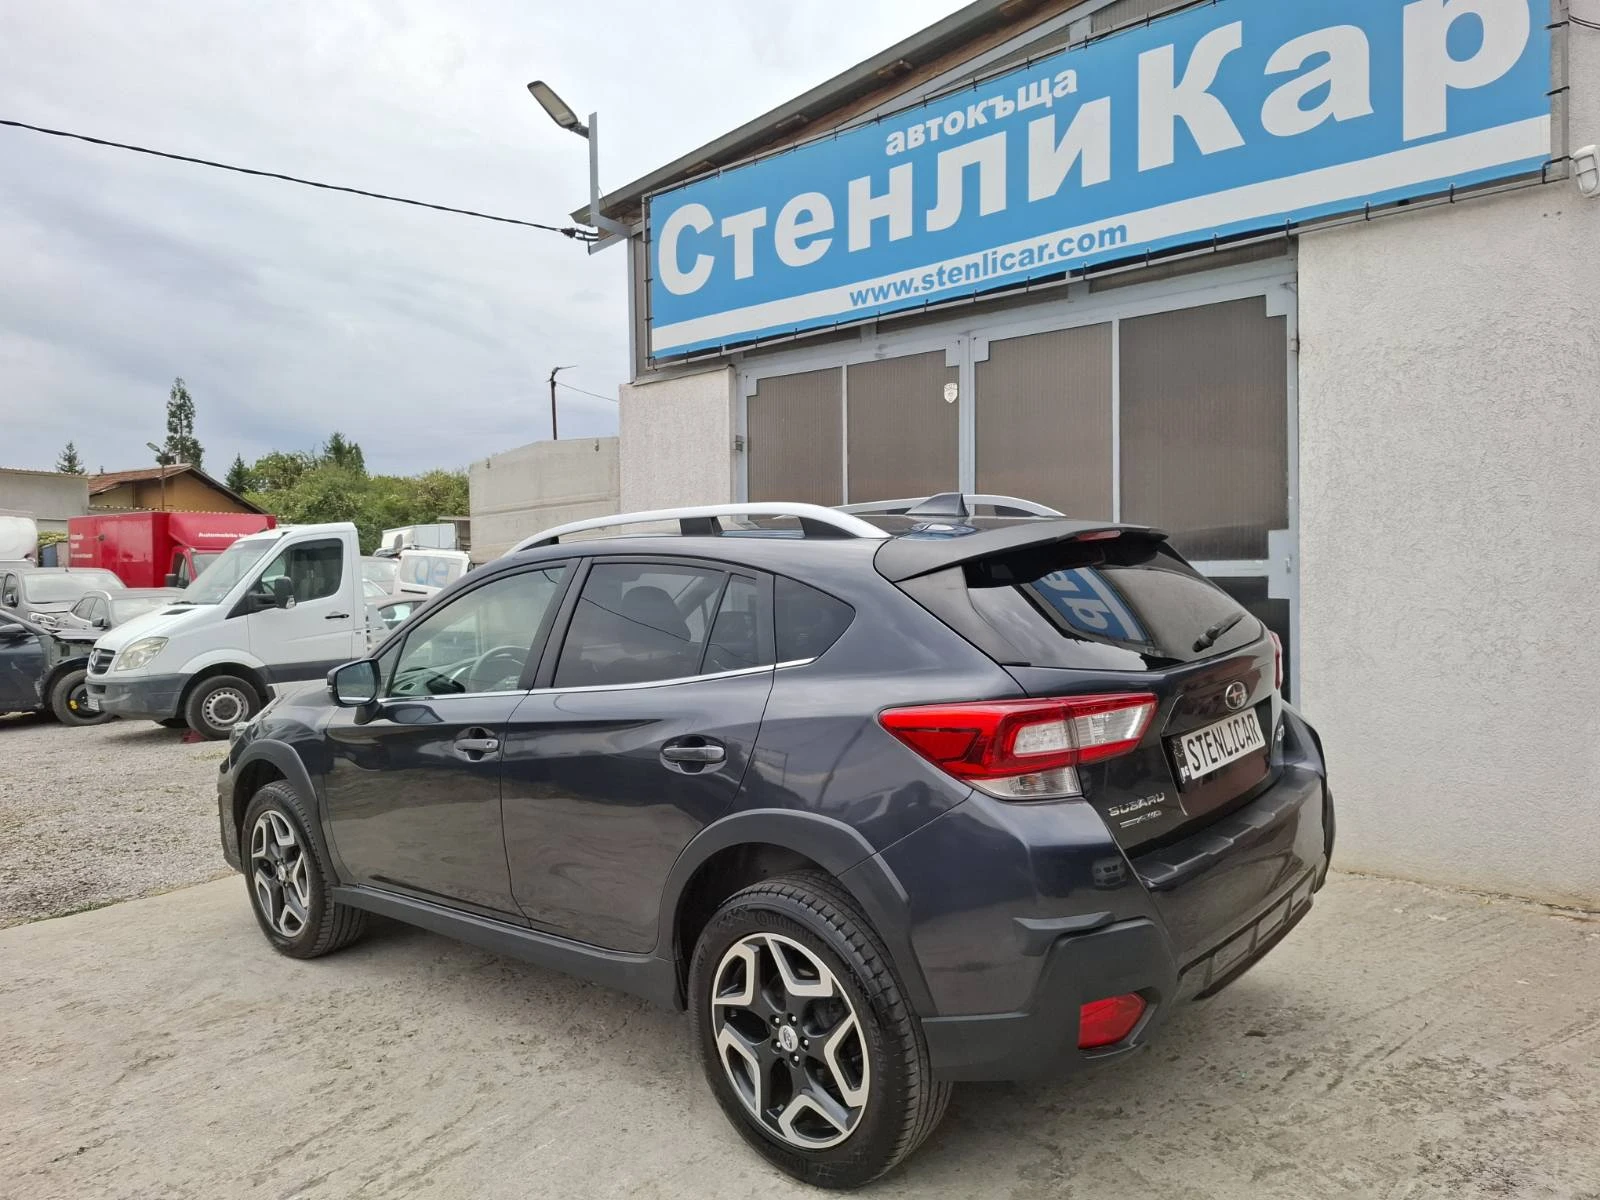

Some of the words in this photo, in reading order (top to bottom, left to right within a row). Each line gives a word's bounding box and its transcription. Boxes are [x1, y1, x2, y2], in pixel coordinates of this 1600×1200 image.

[658, 0, 1531, 296] СтенлиКар
[886, 69, 1078, 156] автокъща
[849, 224, 1128, 307] www.stenlicar.com
[1186, 713, 1262, 772] STENLICAR
[1108, 792, 1165, 817] SUBARU
